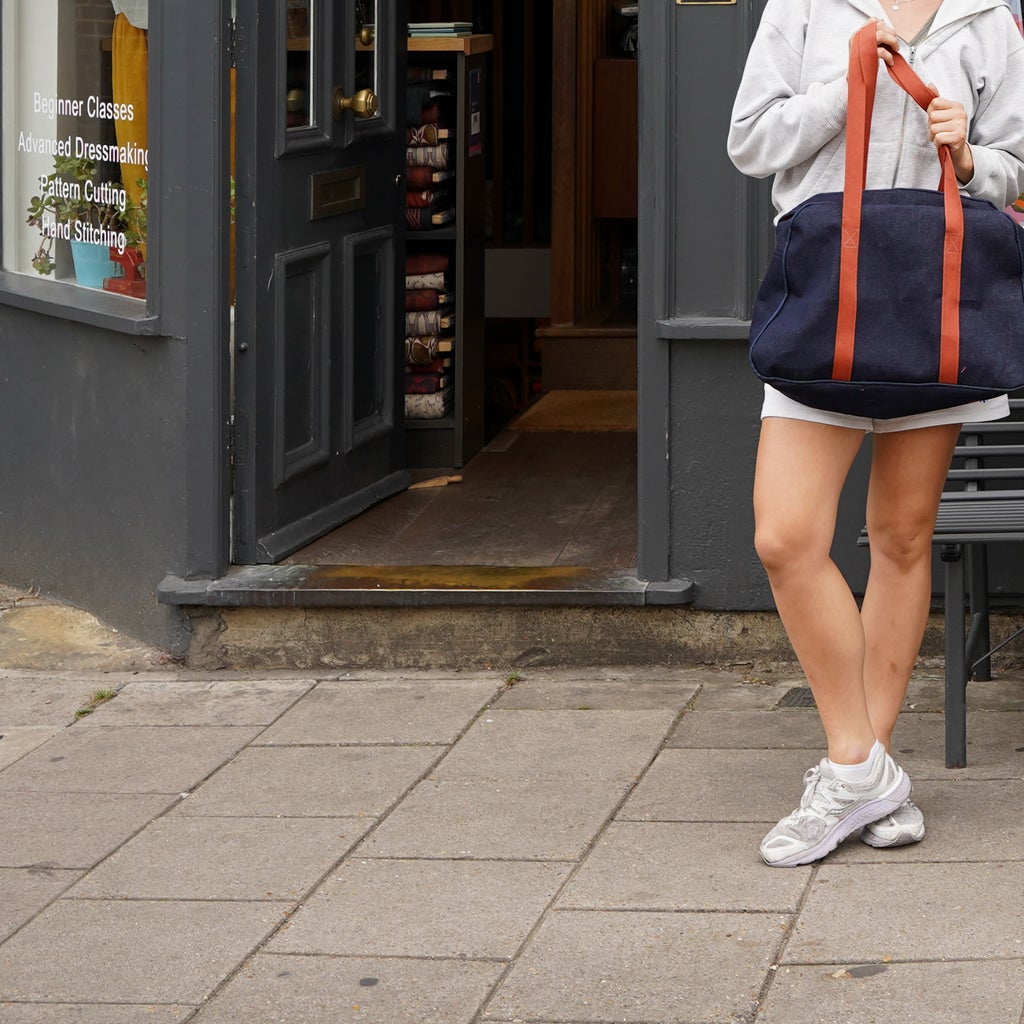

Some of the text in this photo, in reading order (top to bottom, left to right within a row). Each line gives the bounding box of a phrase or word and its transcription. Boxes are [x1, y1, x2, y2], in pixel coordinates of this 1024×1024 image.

[33, 92, 134, 121] Beginner Classes
[18, 132, 71, 158] Advanced
[40, 174, 126, 212] Pattern Cutting
[42, 215, 126, 255] Hand Stitching
